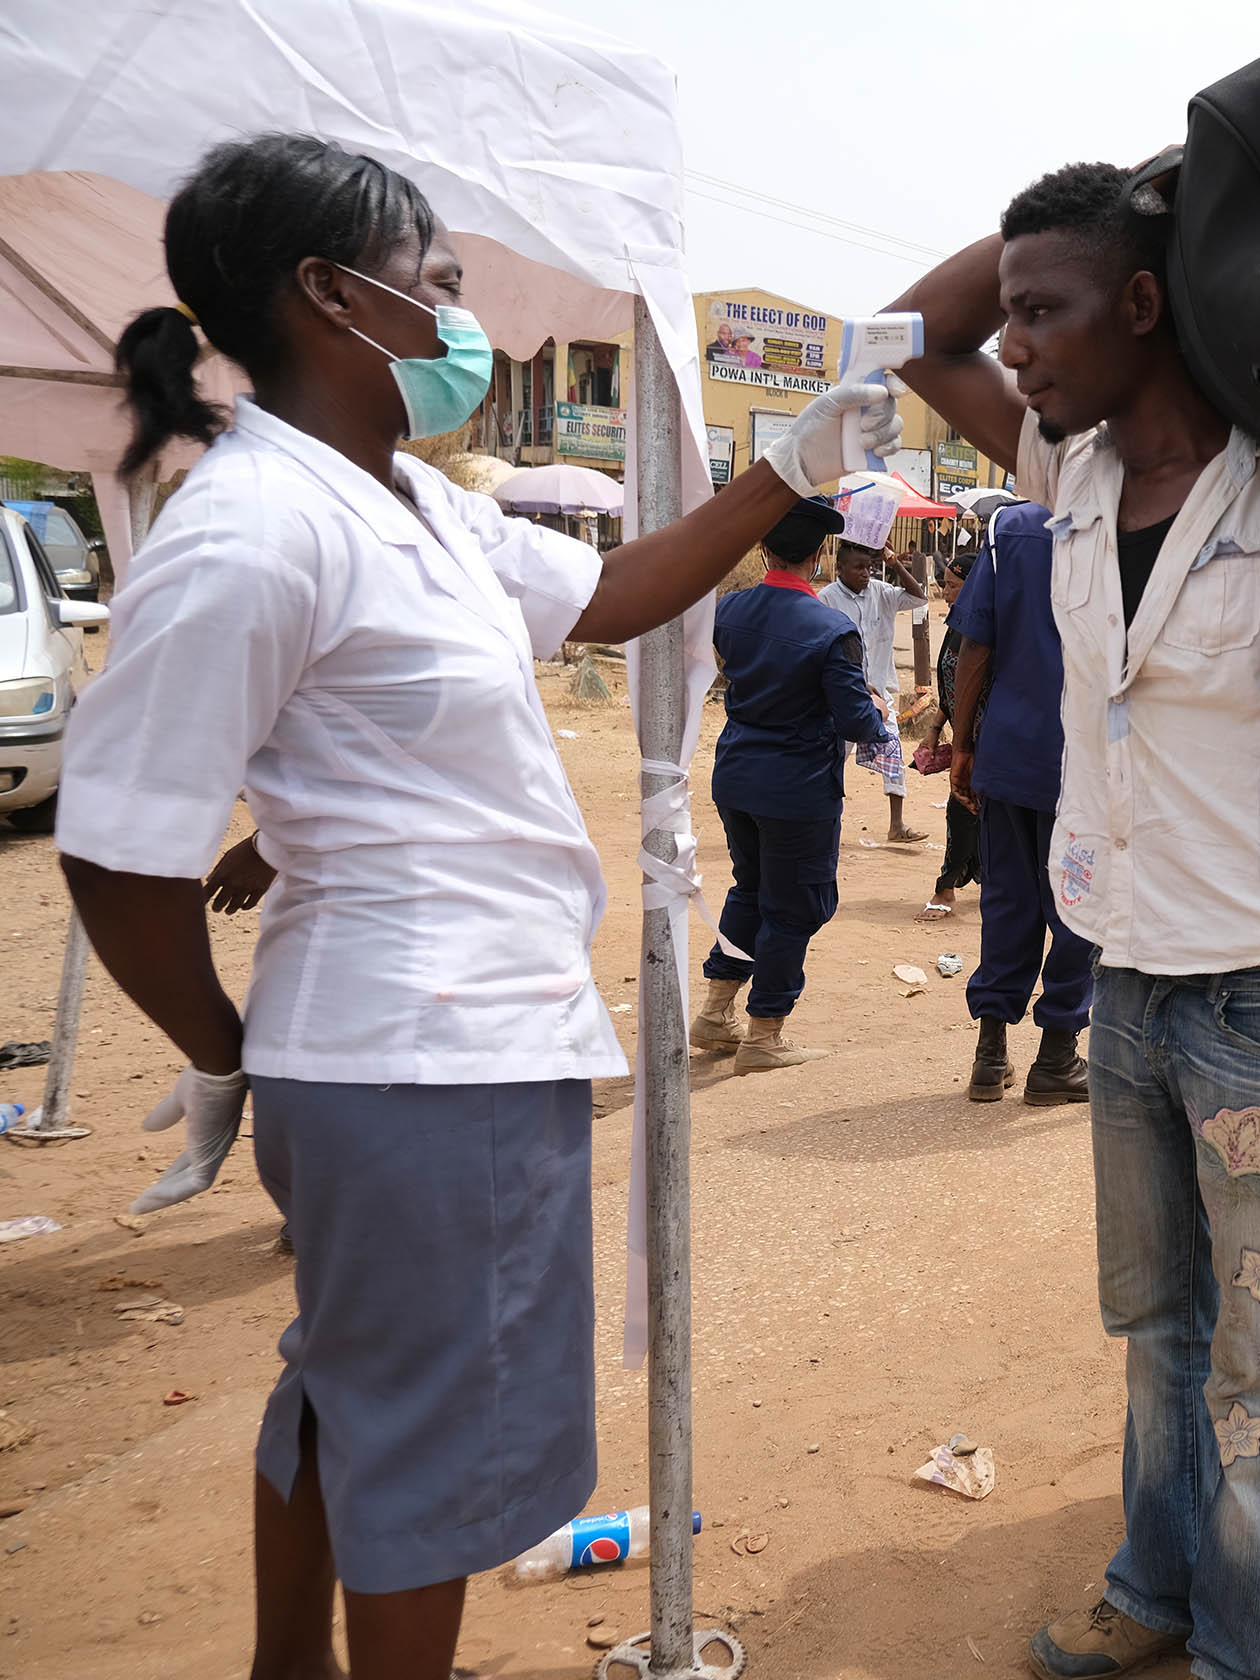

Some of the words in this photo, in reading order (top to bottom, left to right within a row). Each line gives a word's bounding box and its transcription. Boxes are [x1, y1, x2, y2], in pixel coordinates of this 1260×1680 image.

[726, 302, 747, 320] THE
[750, 306, 784, 325] ELECT
[786, 311, 800, 327] OF
[802, 314, 826, 331] GOD
[712, 365, 746, 382] POWA
[750, 371, 780, 387] INT'L
[783, 376, 831, 393] MARKET
[567, 420, 590, 435] ELITES
[945, 446, 976, 461] ELITES
